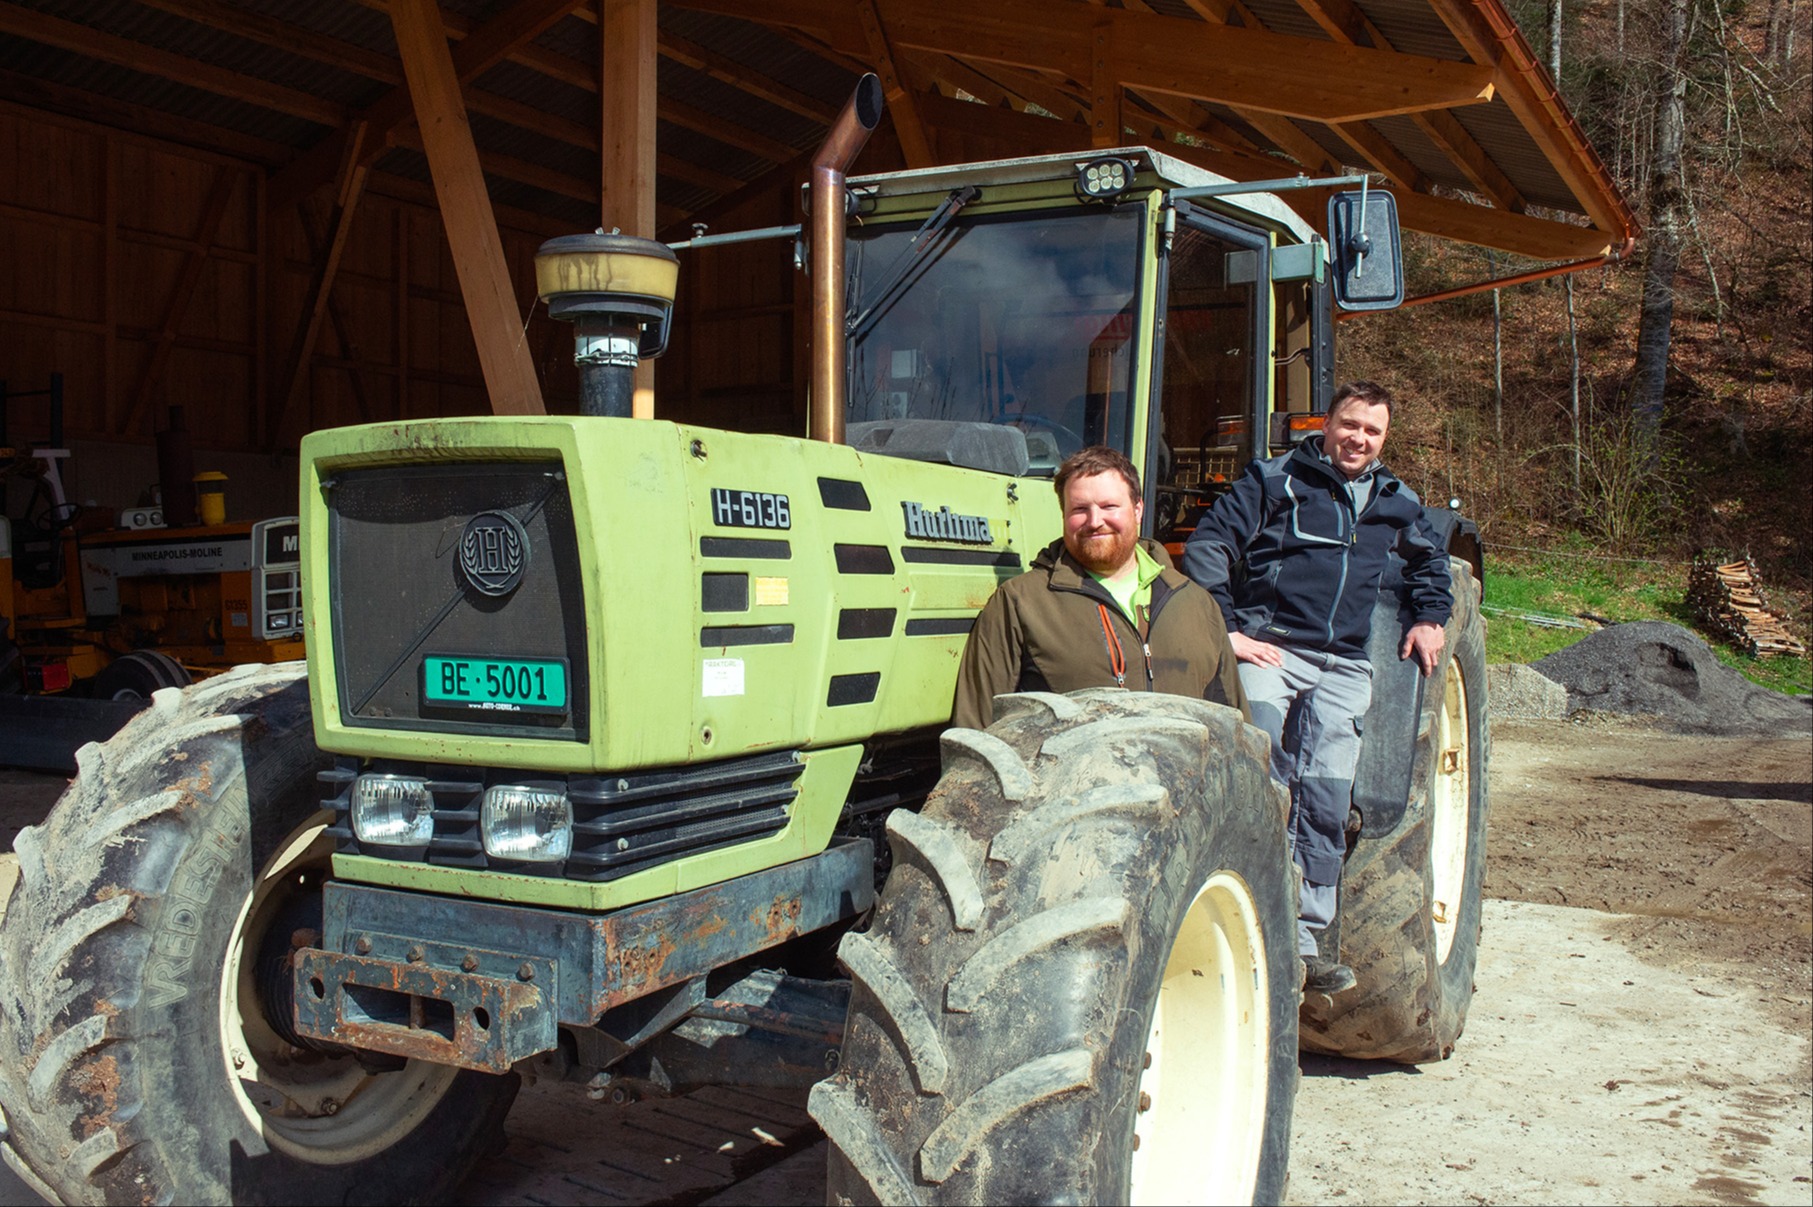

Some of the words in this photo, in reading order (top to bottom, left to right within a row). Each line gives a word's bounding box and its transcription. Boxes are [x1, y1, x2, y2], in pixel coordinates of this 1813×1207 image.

[715, 489, 791, 527] H-6136
[282, 535, 300, 552] M
[131, 547, 223, 561] MINNEAPOLIS-MOLINE
